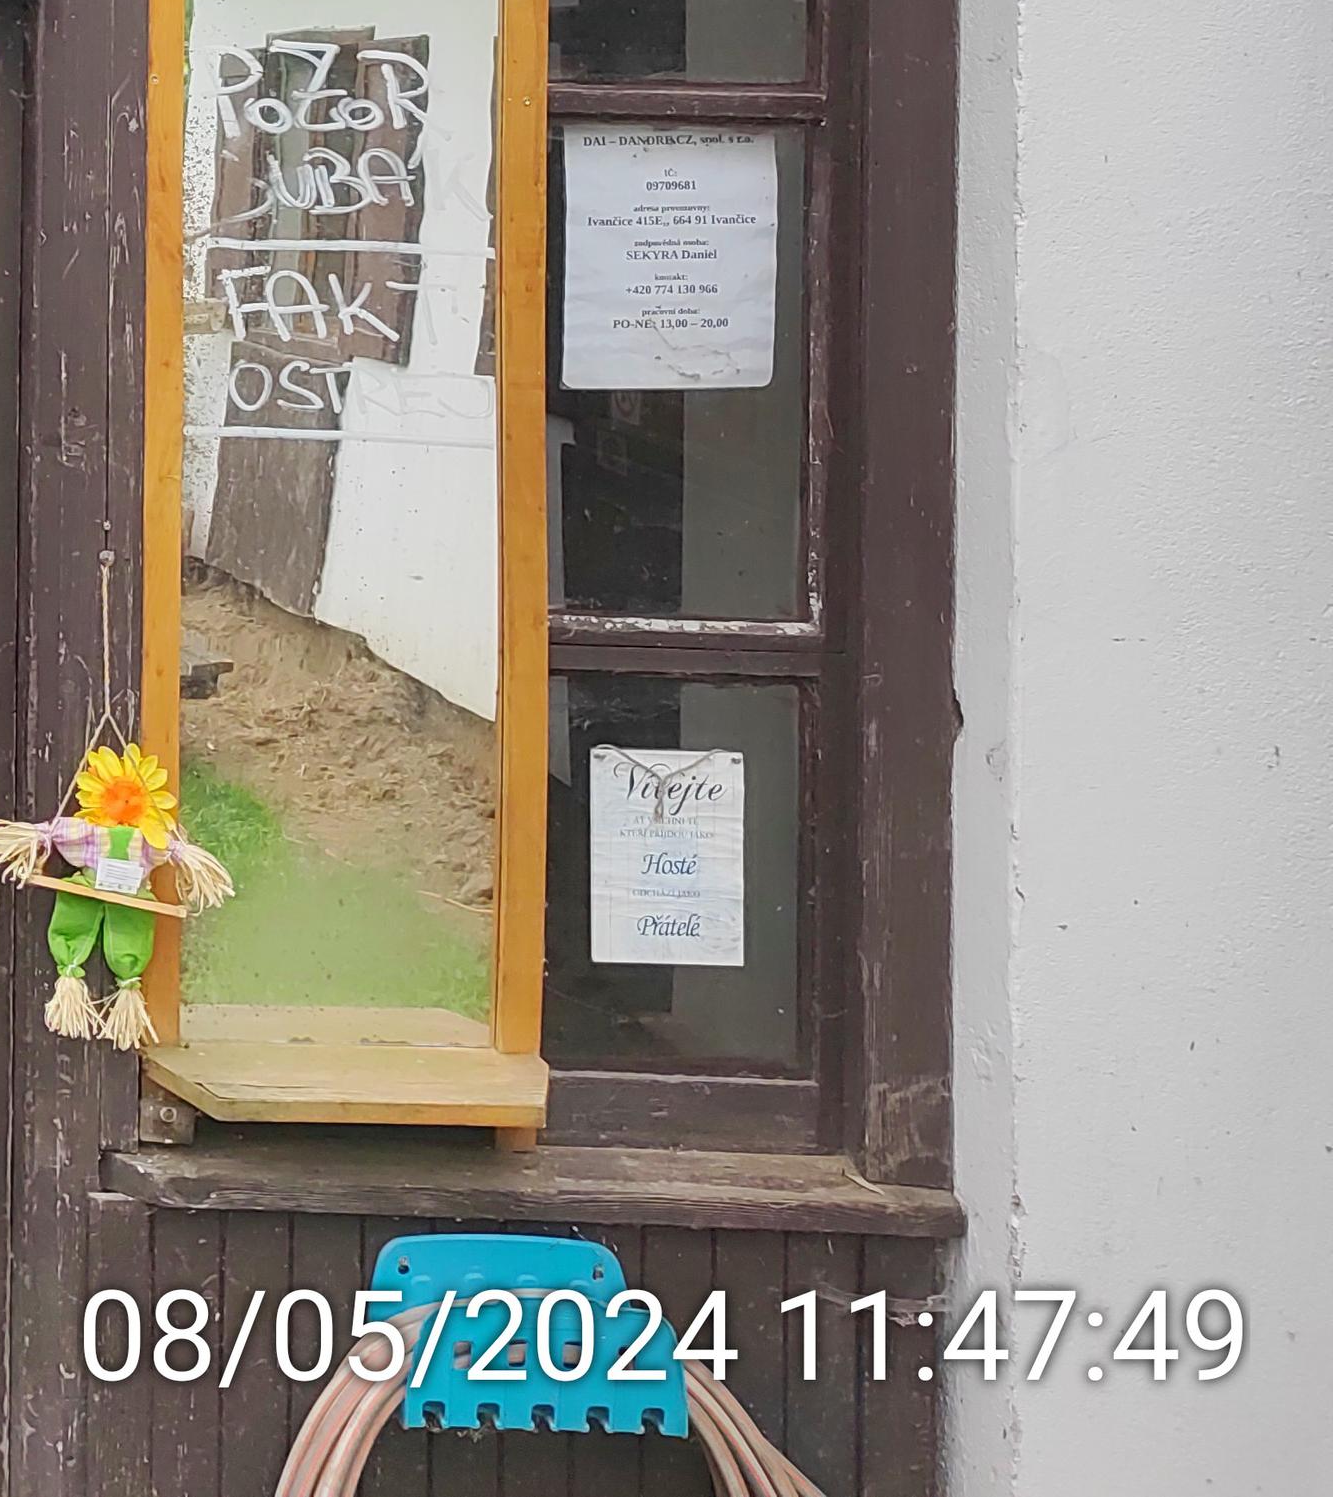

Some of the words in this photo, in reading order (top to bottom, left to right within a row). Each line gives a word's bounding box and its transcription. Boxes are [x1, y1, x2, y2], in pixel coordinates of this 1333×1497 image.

[205, 39, 451, 141] POZOR
[646, 180, 697, 191] 09709681
[587, 216, 633, 227] Ivančice
[673, 215, 692, 225] 664
[694, 215, 708, 225] 91
[710, 214, 757, 225] Ivančice
[626, 250, 679, 261] SEKYRA
[681, 249, 718, 260] Daniel
[625, 285, 652, 295] +420
[654, 284, 674, 295] 774
[677, 284, 696, 294] 130
[699, 284, 718, 294] 966
[660, 318, 688, 330] 13,00
[700, 318, 729, 329] 20,00
[641, 852, 698, 875] Hosté
[637, 913, 701, 937] Přátelé
